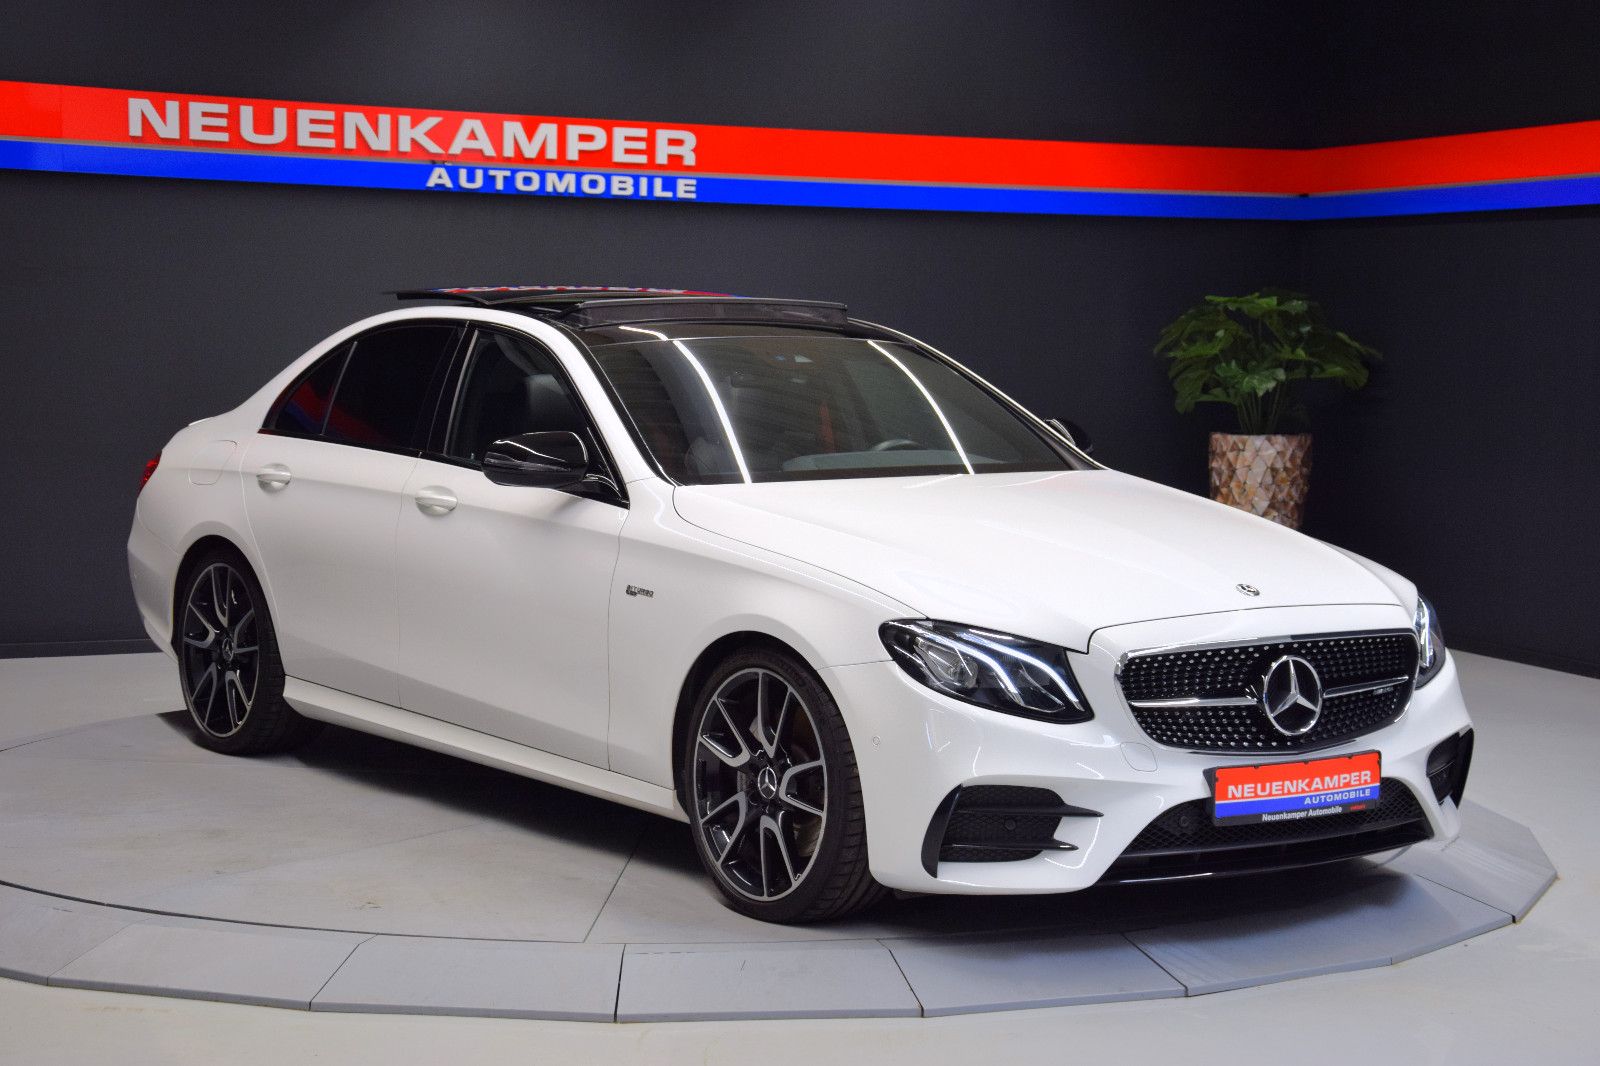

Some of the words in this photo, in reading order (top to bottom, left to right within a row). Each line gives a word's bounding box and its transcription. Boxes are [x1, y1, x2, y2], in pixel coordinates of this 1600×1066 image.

[128, 97, 697, 166] NEUENKAMPER
[426, 167, 697, 199] AUTOMOBILE
[1227, 770, 1371, 798] NEUENKAMPER
[1304, 789, 1371, 805] AUTOMOBILE
[1262, 810, 1308, 822] Neuenkamper
[1308, 805, 1343, 817] Automobile
